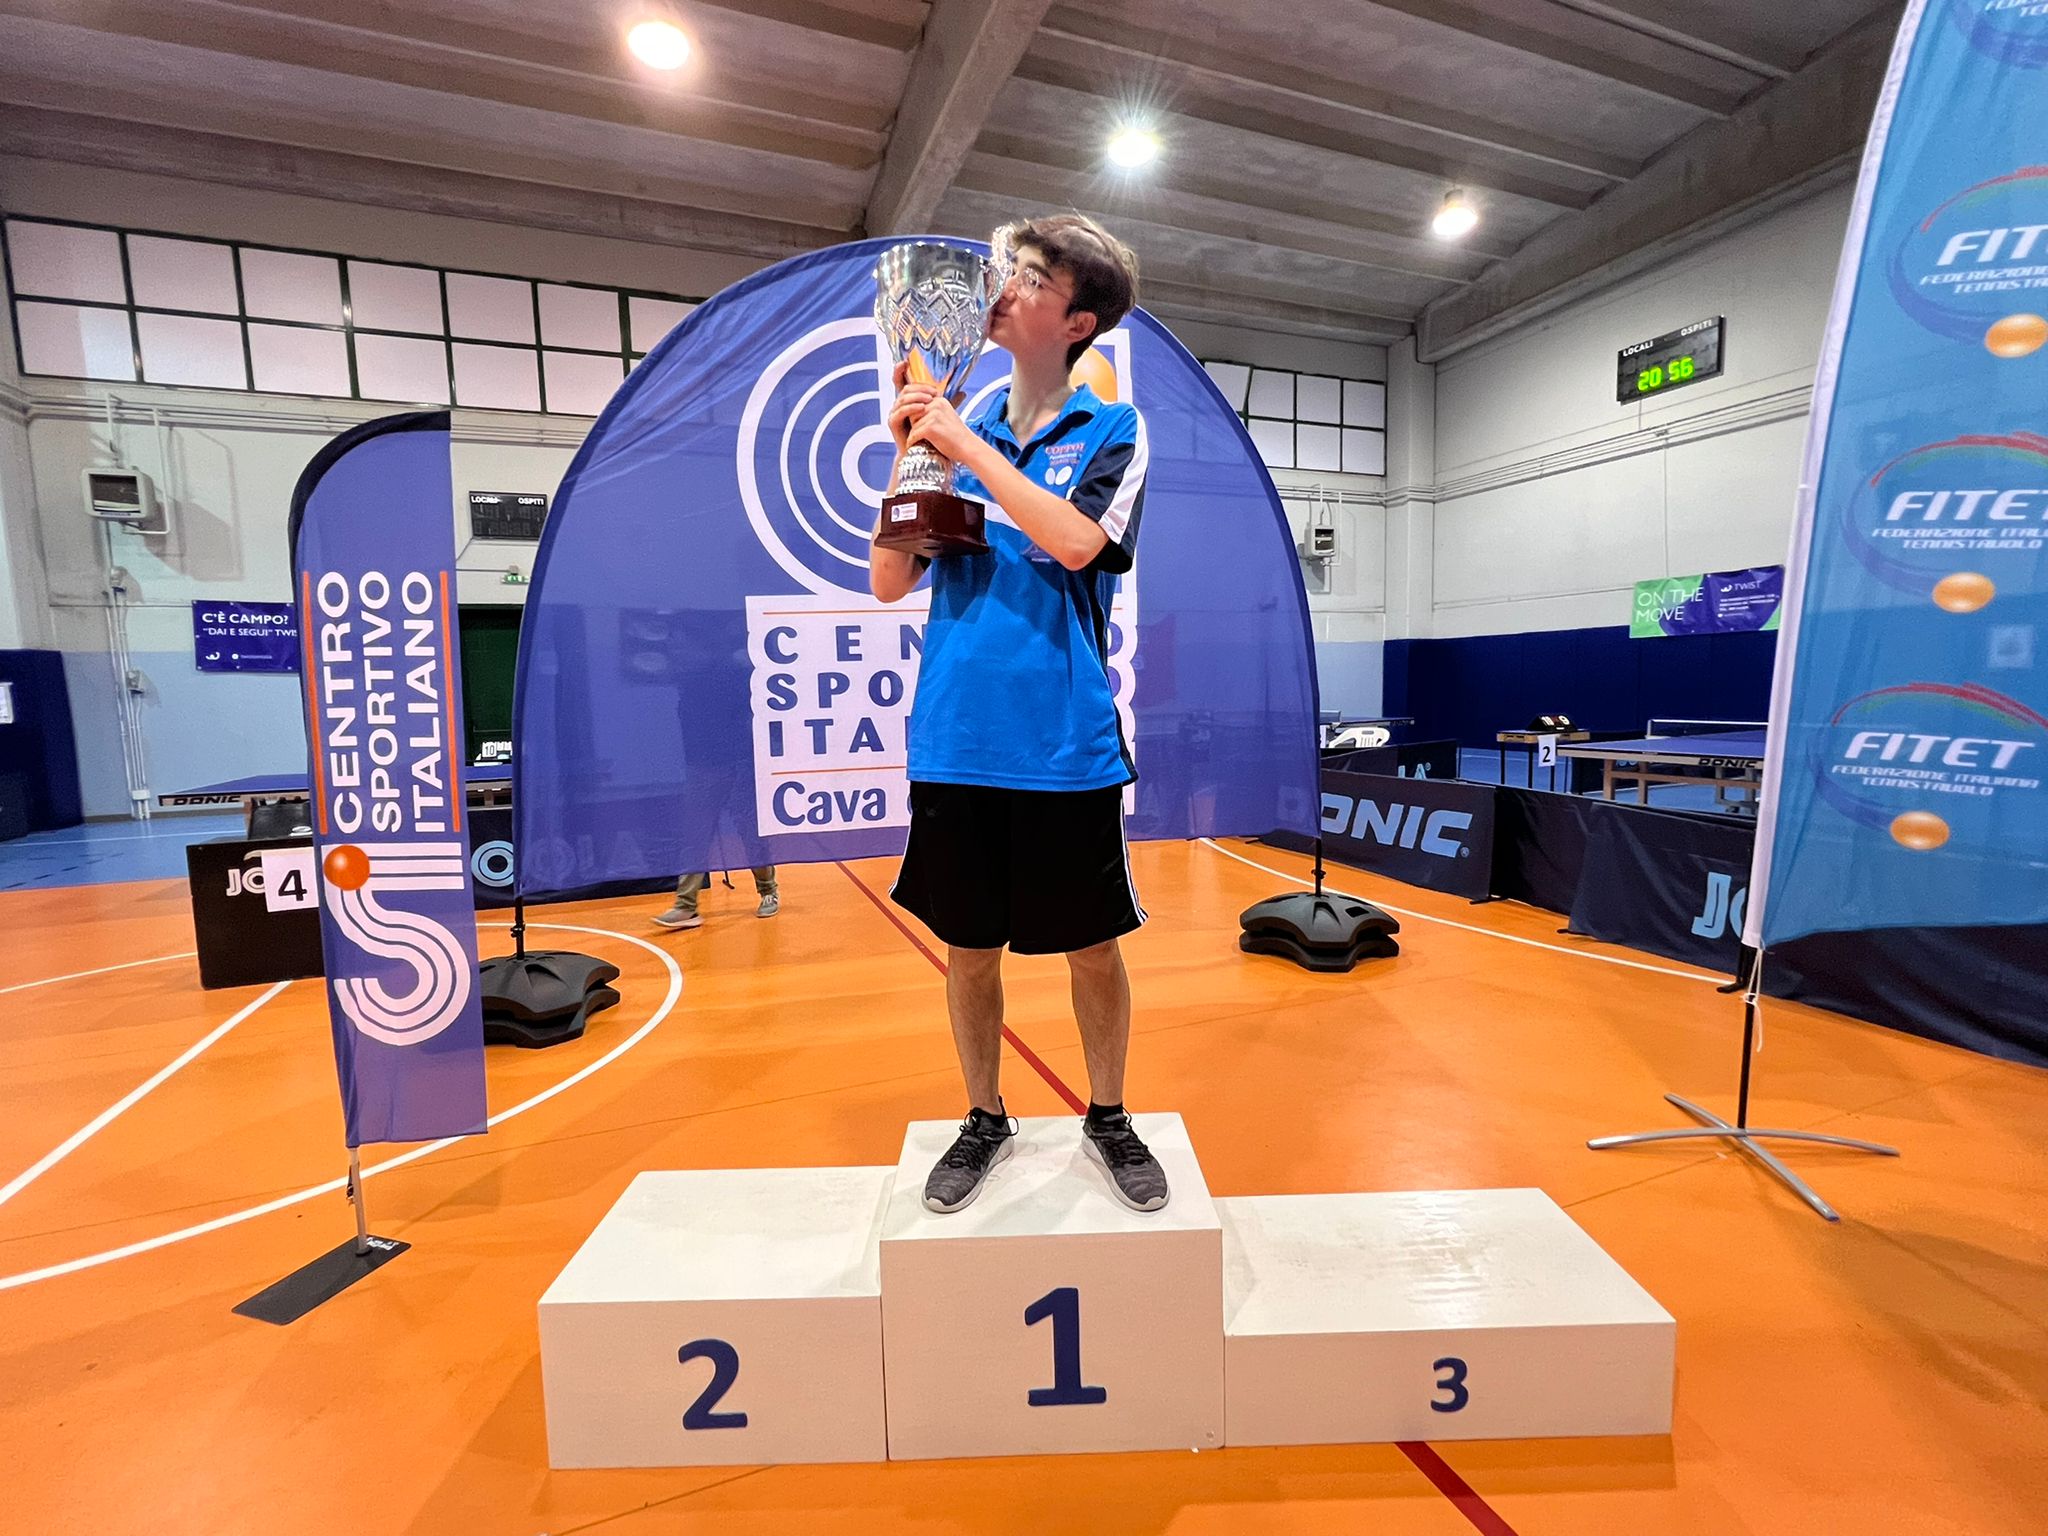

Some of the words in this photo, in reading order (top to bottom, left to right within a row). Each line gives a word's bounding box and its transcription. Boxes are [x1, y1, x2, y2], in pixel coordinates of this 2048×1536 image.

[1936, 224, 2048, 266] FIT
[1622, 340, 1654, 357] LOCALI
[1680, 319, 1712, 336] OSPITI
[1637, 366, 1662, 391] 20
[1668, 356, 1694, 381] 56
[1872, 528, 1995, 538] FEDERAZIONE
[1903, 539, 2043, 549] TENNISTAVOLO
[1638, 593, 1664, 607] ON
[1670, 587, 1704, 603] THE
[1734, 580, 1762, 591] TWIST
[229, 613, 289, 625] CAMPO?
[1635, 606, 1685, 623] MOVE
[229, 628, 236, 636] E
[317, 571, 363, 834] CENTRO
[358, 571, 402, 833] SPORTIVO
[401, 571, 446, 833] ITALIANO
[1542, 745, 1552, 763] 2
[1698, 758, 1758, 769] DONIC
[1844, 731, 2036, 770] FITET
[1831, 764, 1948, 782] FEDERAZIONE
[173, 796, 241, 806] DONIC
[772, 780, 887, 827] Cava
[278, 869, 308, 902] 4
[1024, 1287, 1107, 1407] 1
[678, 1338, 748, 1430] 2
[1430, 1357, 1469, 1413] 3
